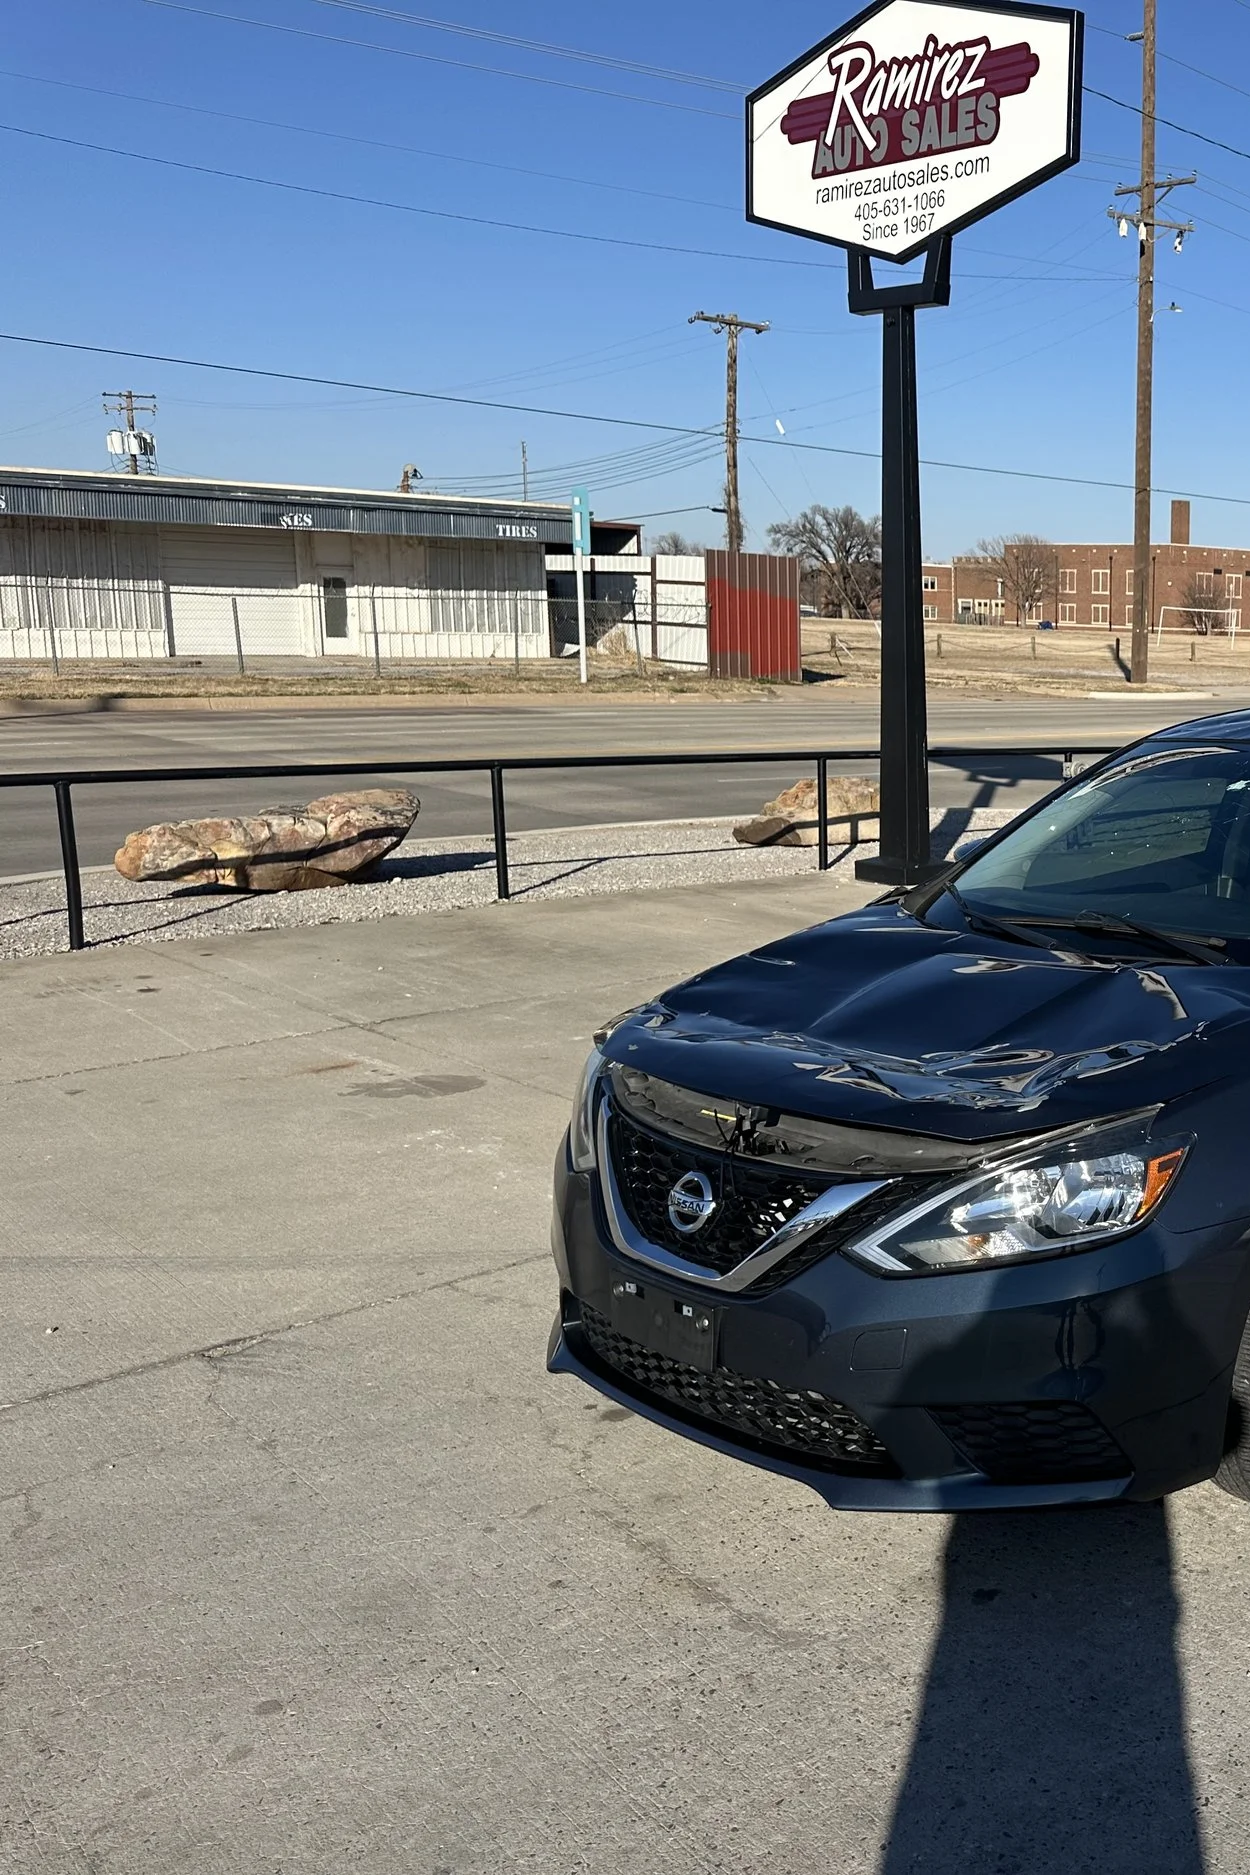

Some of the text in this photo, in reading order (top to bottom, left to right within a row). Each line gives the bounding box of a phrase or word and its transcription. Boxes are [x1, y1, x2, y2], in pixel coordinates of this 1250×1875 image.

[825, 40, 988, 152] Ramirez
[814, 91, 997, 175] AUTO SALES
[816, 155, 990, 204] ramirezautosales.com
[854, 189, 945, 221] 405-631-1066
[862, 212, 935, 241] Since 1967
[496, 524, 538, 538] TIRES
[669, 1191, 705, 1213] NISSAN
